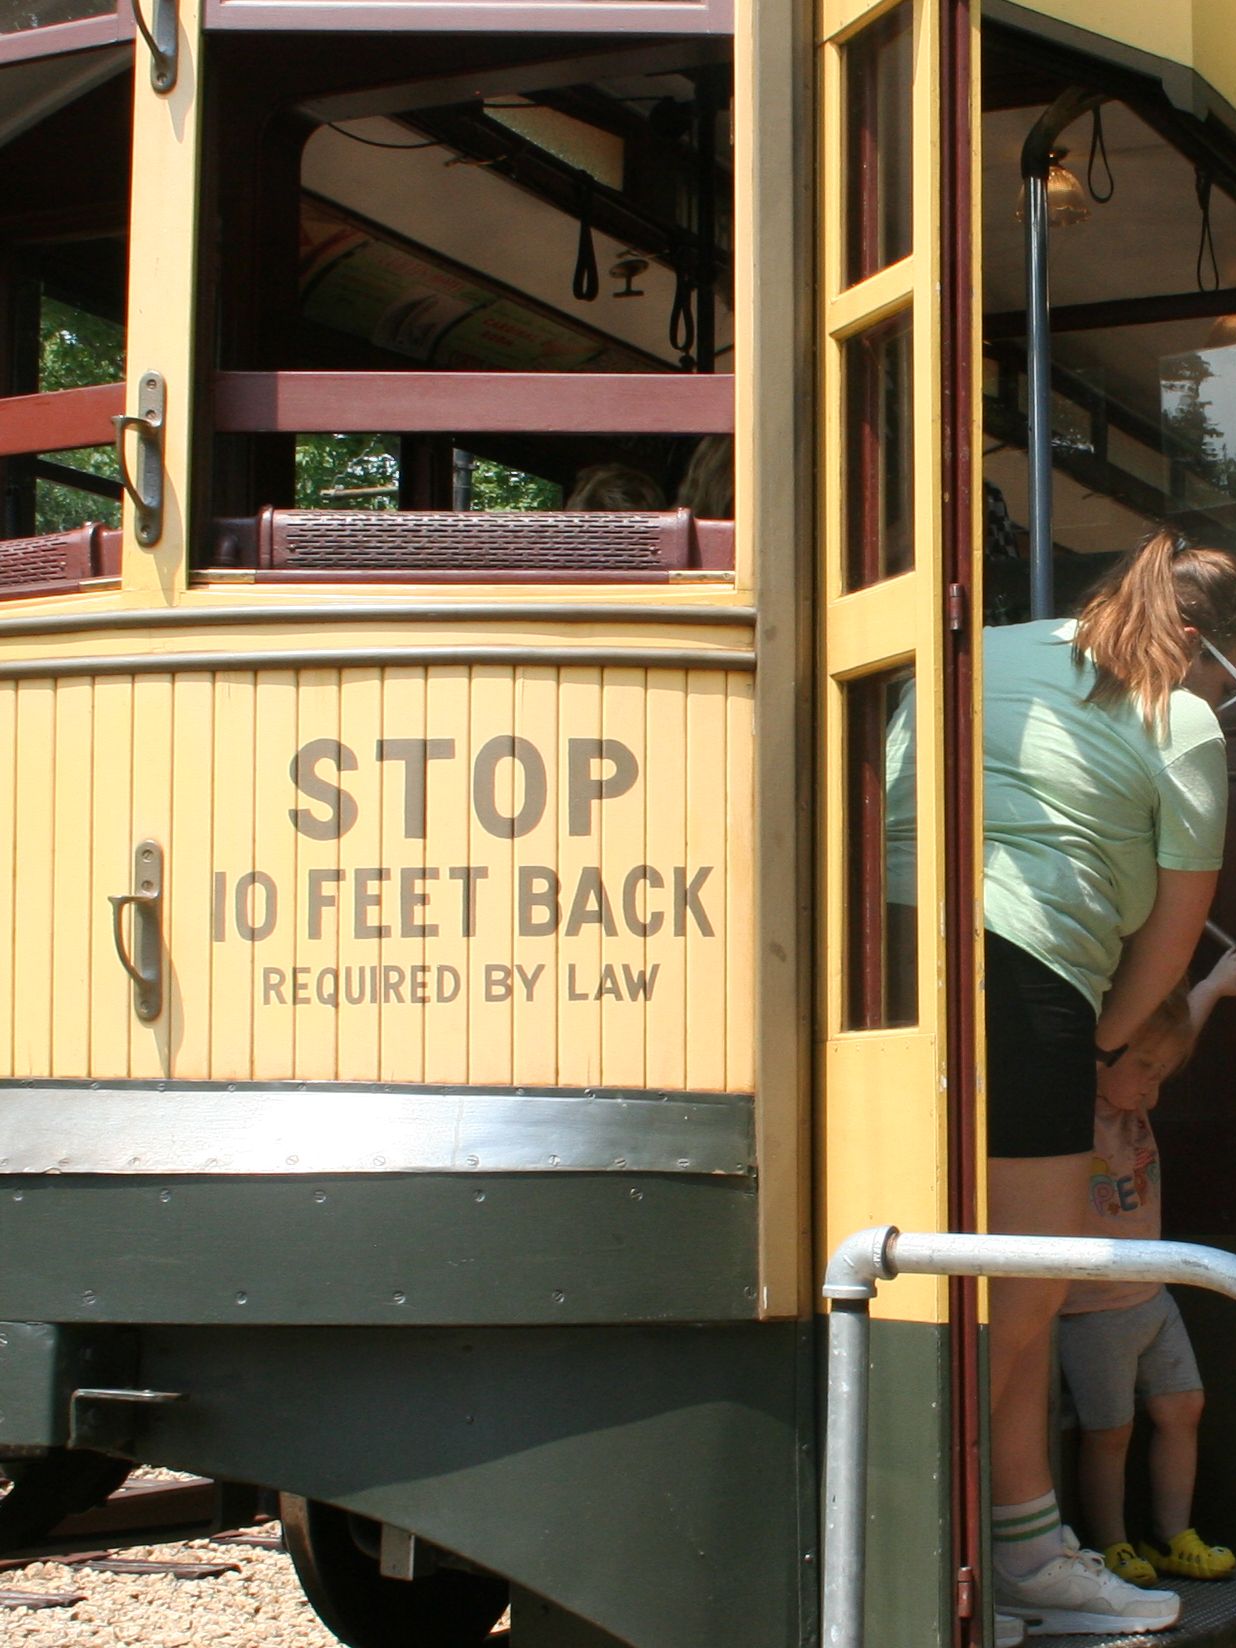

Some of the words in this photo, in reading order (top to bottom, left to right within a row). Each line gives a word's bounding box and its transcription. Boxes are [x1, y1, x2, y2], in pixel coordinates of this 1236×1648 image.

[288, 735, 640, 841] STOP
[212, 870, 278, 943] 10
[307, 866, 489, 941] FEET
[518, 865, 715, 939] BACK
[262, 965, 461, 1008] REQUIRED
[485, 964, 544, 1003] BY
[567, 963, 661, 1003] LAW
